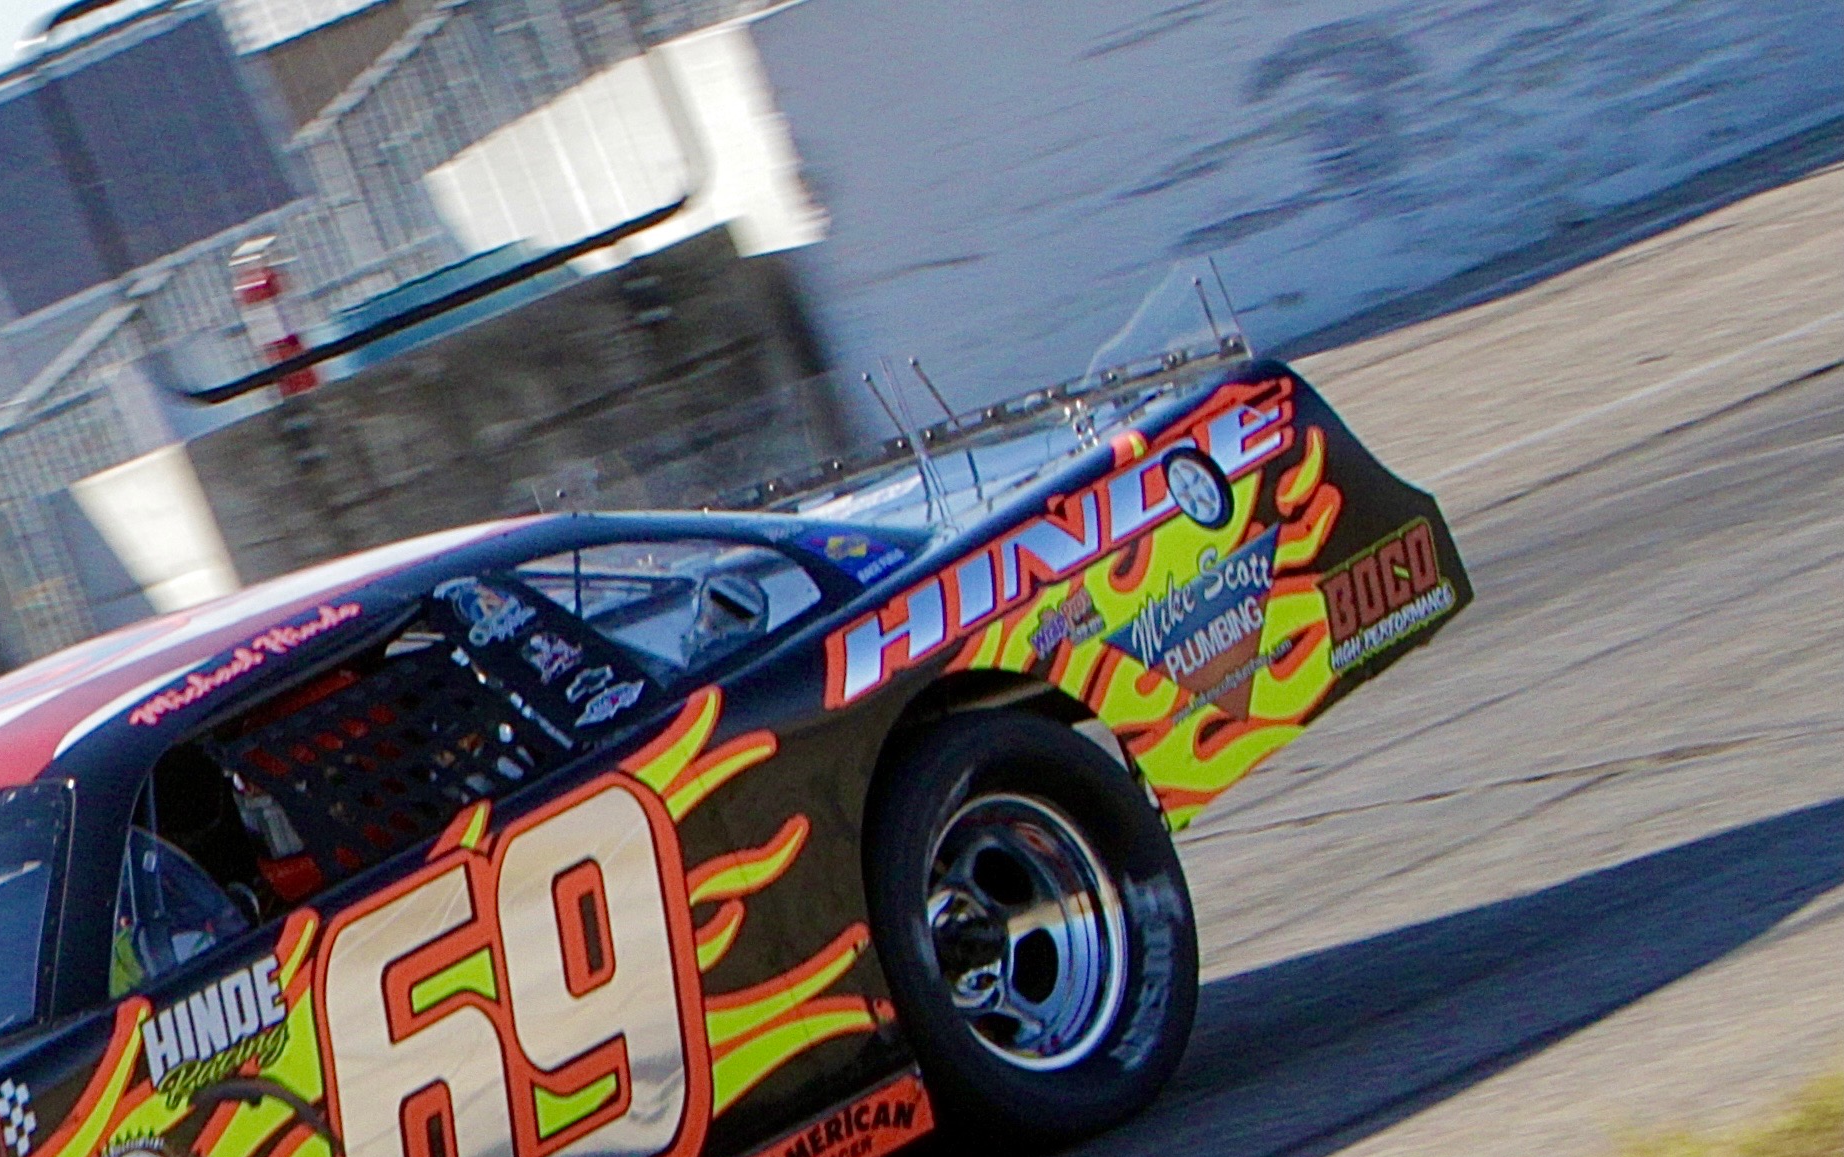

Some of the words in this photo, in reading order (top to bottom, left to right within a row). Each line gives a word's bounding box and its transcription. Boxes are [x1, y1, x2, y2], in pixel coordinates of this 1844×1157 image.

[836, 395, 1286, 705] HINDE
[1131, 570, 1196, 671] Mike
[1198, 546, 1273, 600] Scott
[1164, 595, 1264, 683] PLUMBING
[128, 647, 265, 726] Michael
[141, 954, 287, 1089] HINDE
[157, 1021, 290, 1110] Racing
